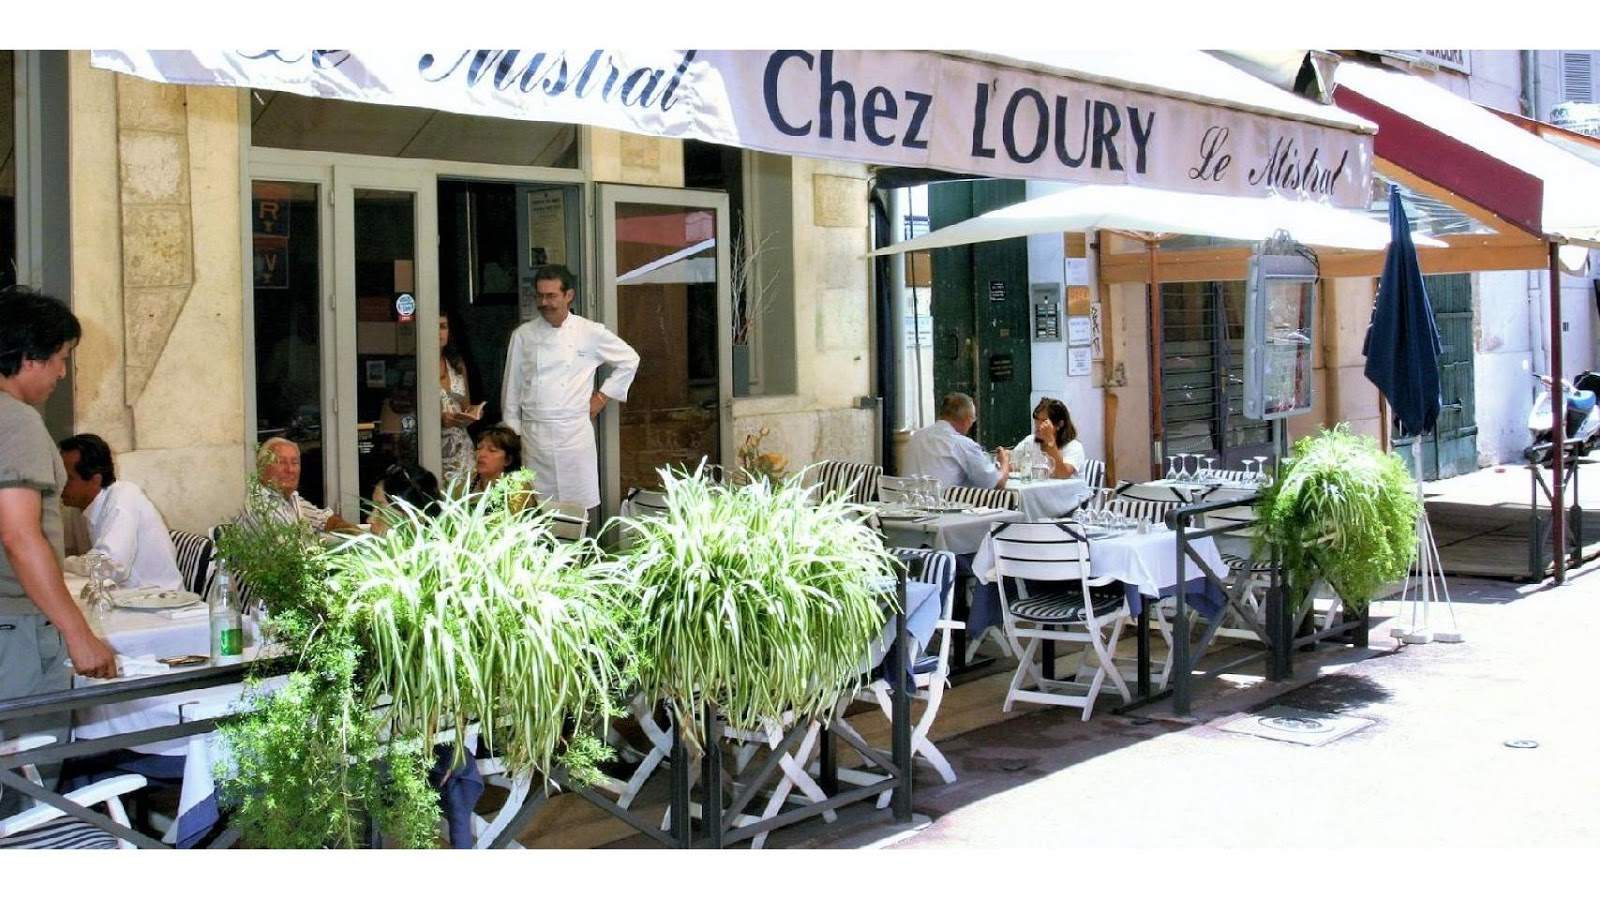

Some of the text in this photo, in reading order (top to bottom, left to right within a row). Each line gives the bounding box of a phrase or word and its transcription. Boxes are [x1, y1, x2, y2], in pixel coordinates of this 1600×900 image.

[763, 50, 932, 149] Chez
[1188, 125, 1349, 195] Le Mistral
